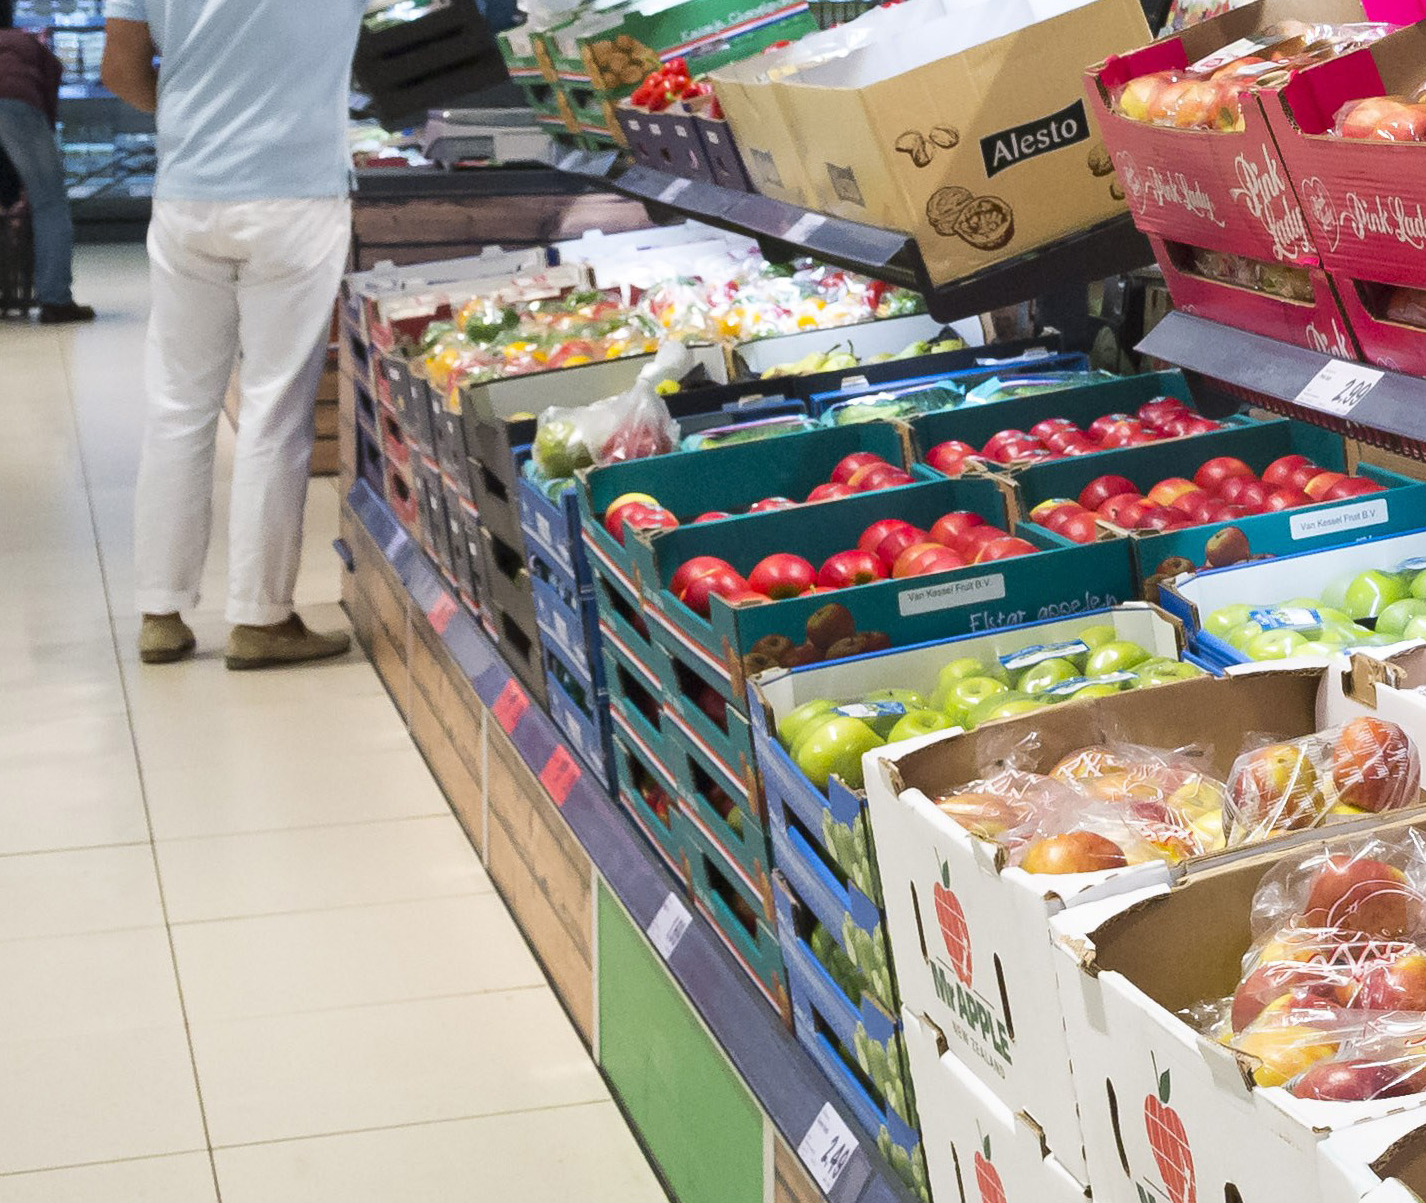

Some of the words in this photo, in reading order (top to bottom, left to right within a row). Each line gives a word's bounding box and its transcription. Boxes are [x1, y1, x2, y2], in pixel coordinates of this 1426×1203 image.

[993, 119, 1078, 167] Alesto
[1229, 143, 1286, 218] Pink
[1261, 196, 1320, 261] Lady
[1339, 192, 1394, 240] Pink
[1331, 378, 1373, 407] 2.99
[1300, 523, 1316, 531] Van
[1317, 517, 1343, 529] Kessel
[1344, 513, 1361, 524] Fruit
[907, 592, 925, 603] Van
[926, 584, 955, 599] Kessel
[955, 579, 974, 593] Fruit
[930, 959, 957, 1012] Mr
[955, 982, 1014, 1067] APPLE
